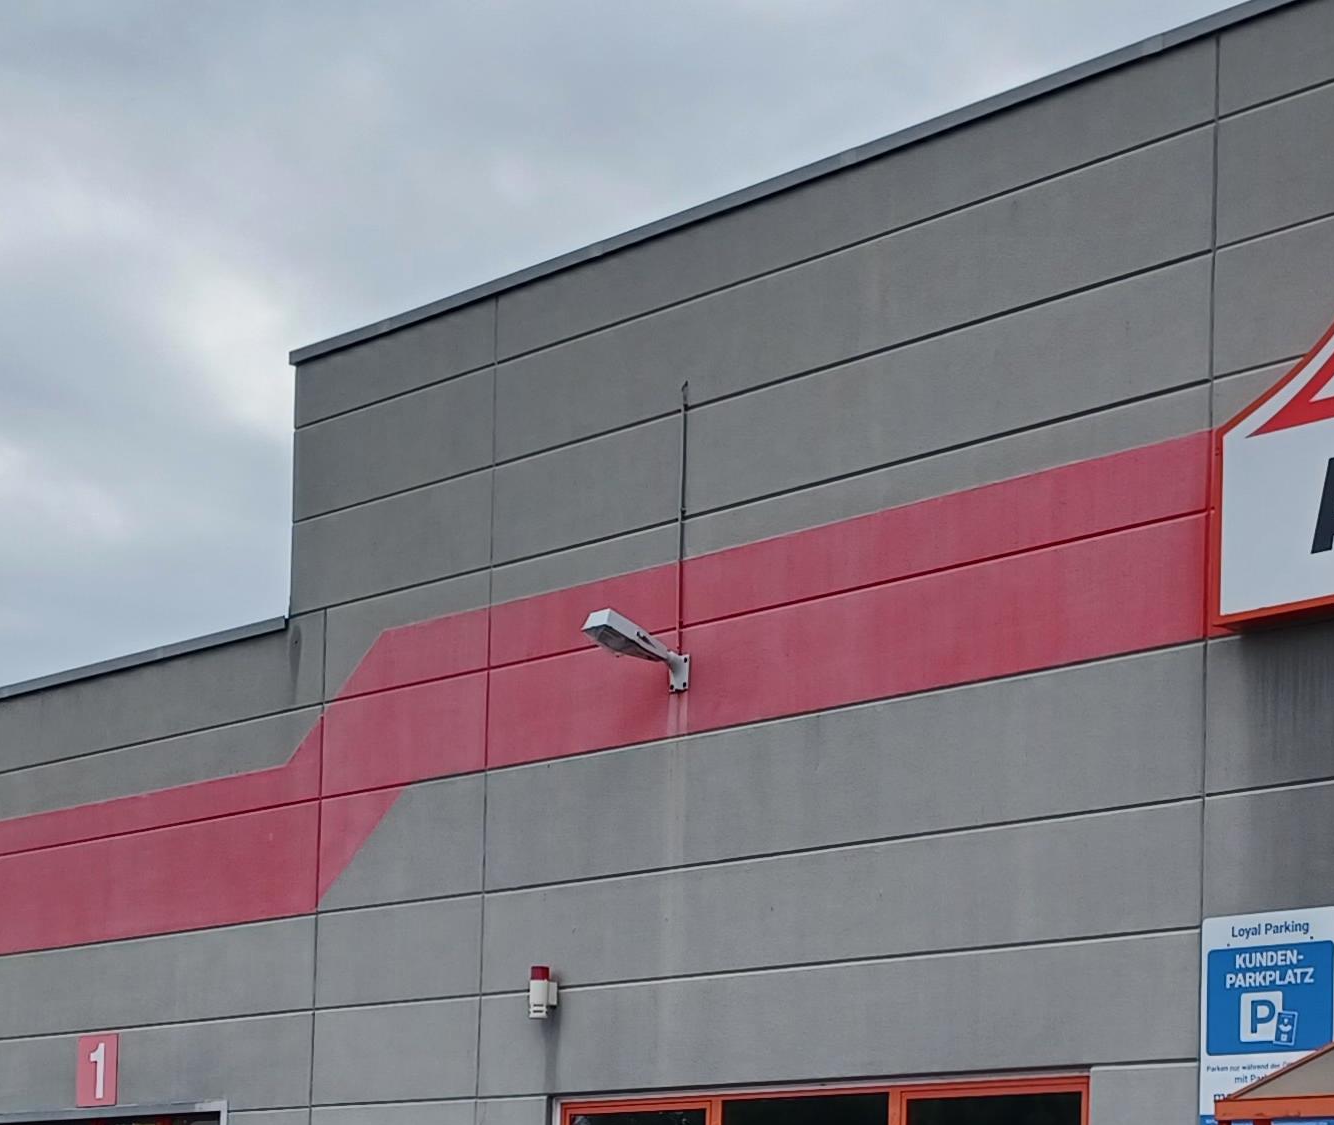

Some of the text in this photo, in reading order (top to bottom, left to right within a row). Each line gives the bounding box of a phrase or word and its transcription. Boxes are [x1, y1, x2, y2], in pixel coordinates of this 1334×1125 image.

[1231, 920, 1310, 939] Loyal Parking
[1235, 949, 1304, 969] KUNDEN-
[1225, 967, 1315, 989] PARKPLATZ
[90, 1043, 106, 1099] 1
[1234, 1074, 1248, 1084] mit
